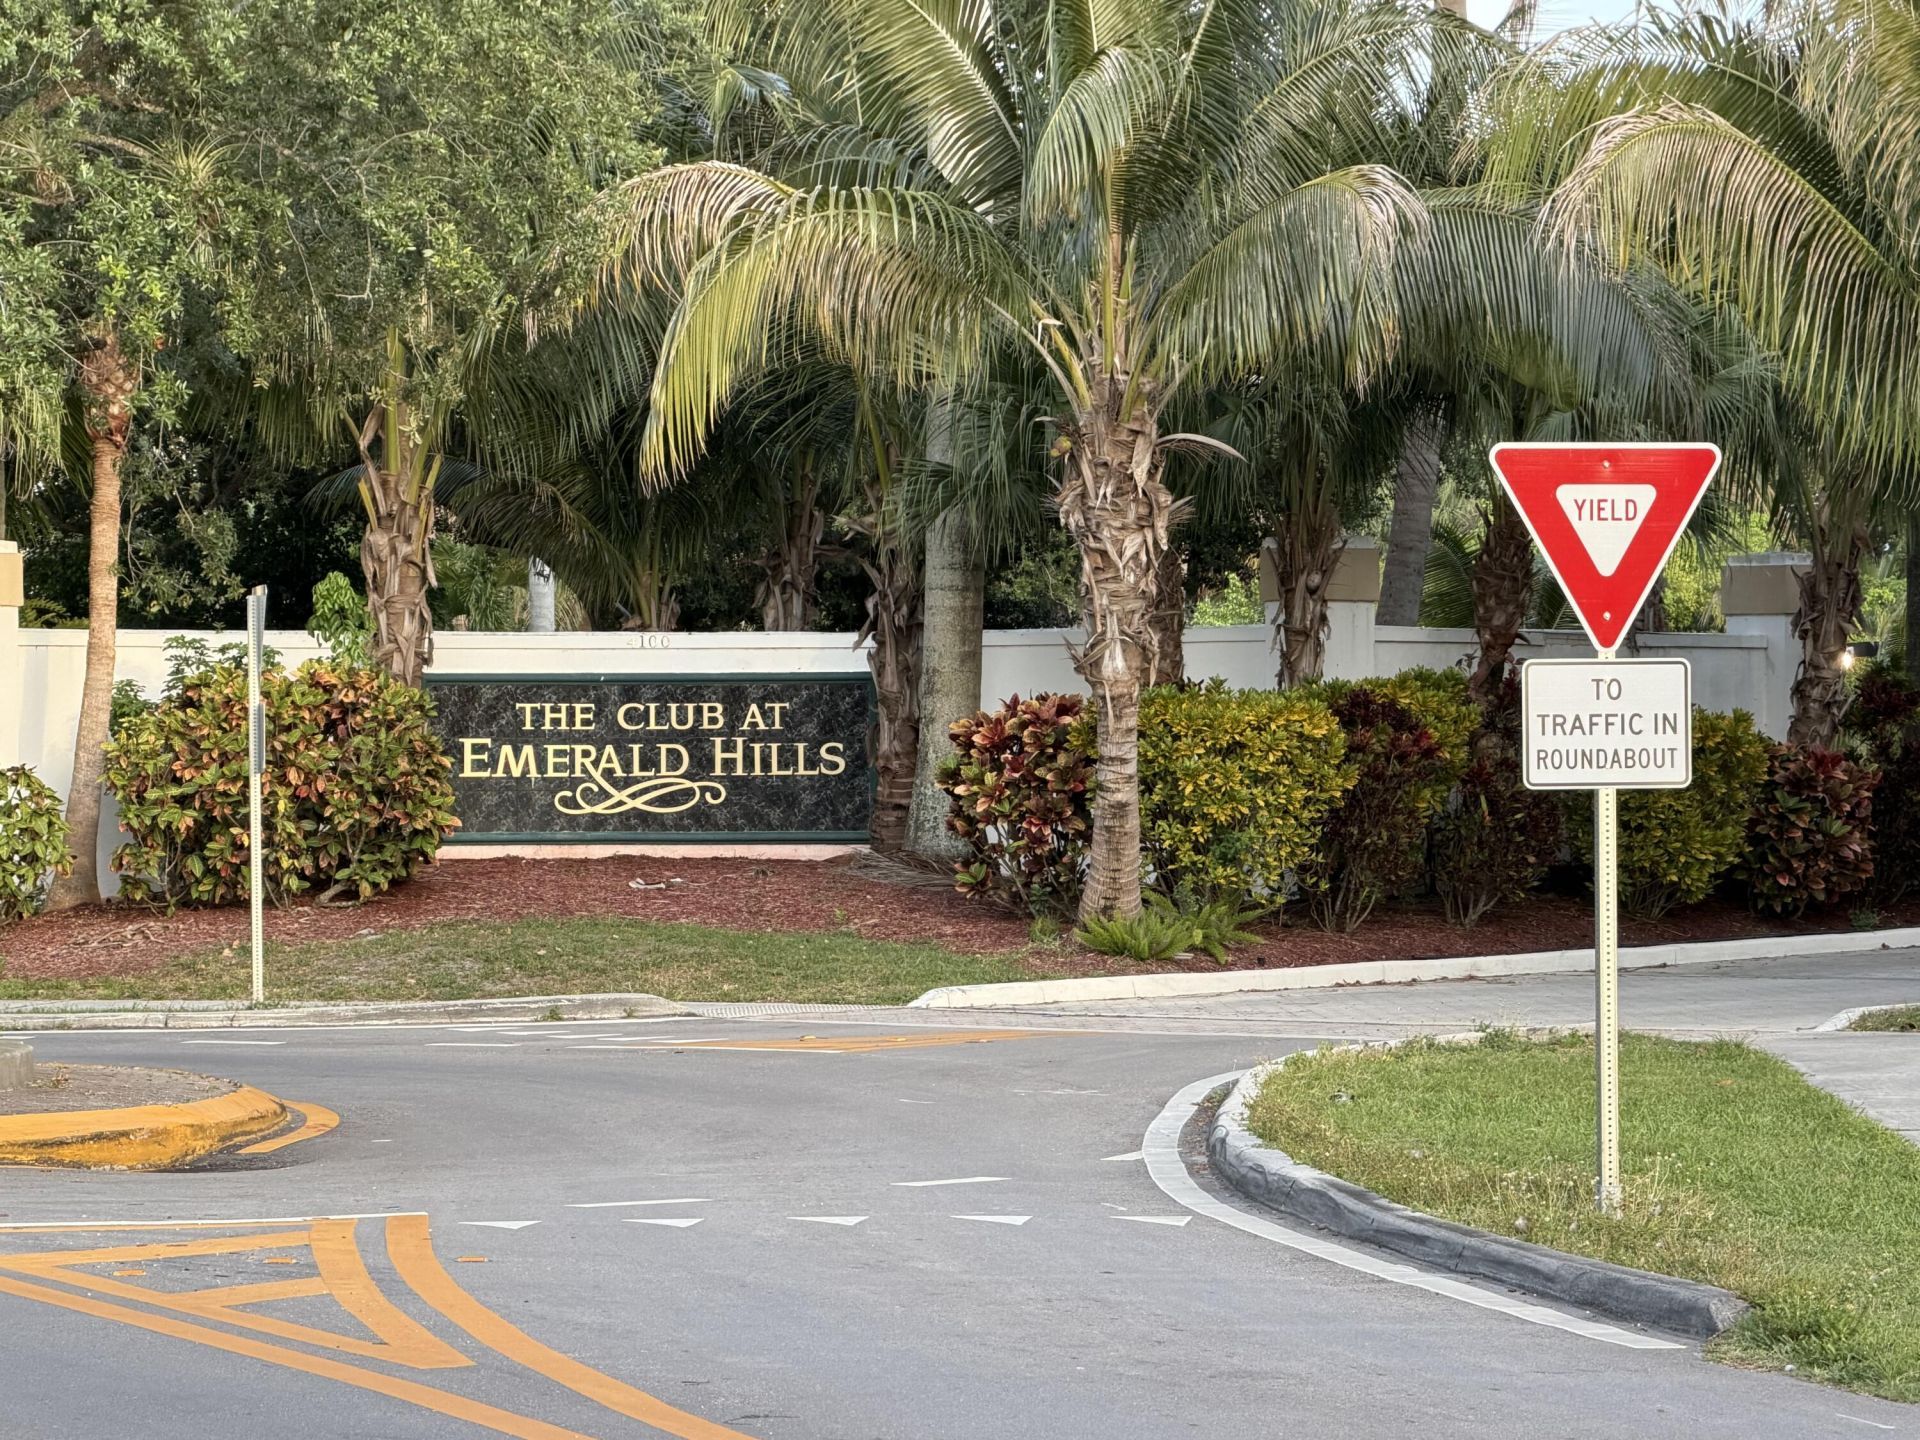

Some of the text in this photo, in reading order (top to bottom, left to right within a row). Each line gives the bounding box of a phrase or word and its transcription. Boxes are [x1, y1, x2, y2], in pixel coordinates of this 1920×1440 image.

[1573, 499, 1638, 522] YIELD
[1591, 678, 1622, 701] TO
[515, 702, 790, 731] THE CLUB AT
[1536, 713, 1678, 736] TRAFFIC IN
[458, 736, 847, 778] EMERALD HILLS
[1536, 747, 1678, 770] ROUNDABOUT
